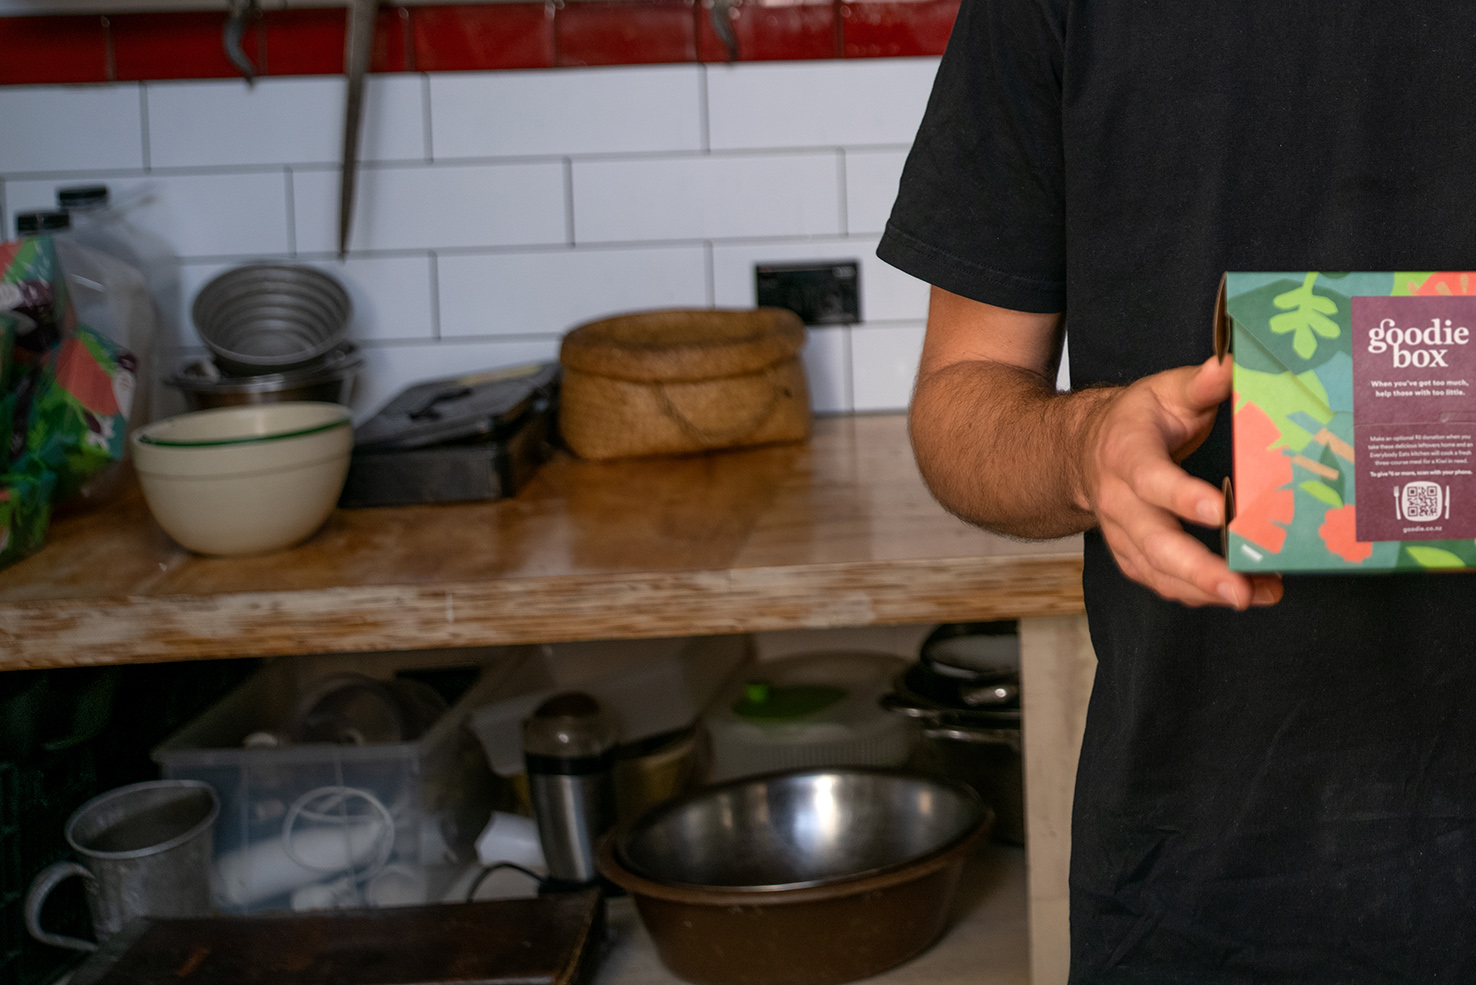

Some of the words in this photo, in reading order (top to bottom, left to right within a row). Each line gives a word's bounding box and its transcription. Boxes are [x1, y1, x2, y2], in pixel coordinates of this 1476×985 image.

[1368, 318, 1470, 354] goodie
[1393, 346, 1449, 368] box
[1393, 379, 1417, 388] you've
[1375, 390, 1391, 398] help
[1393, 434, 1414, 442] optional
[1370, 451, 1398, 459] Everybody
[1403, 526, 1442, 534] goodie.co.nz
